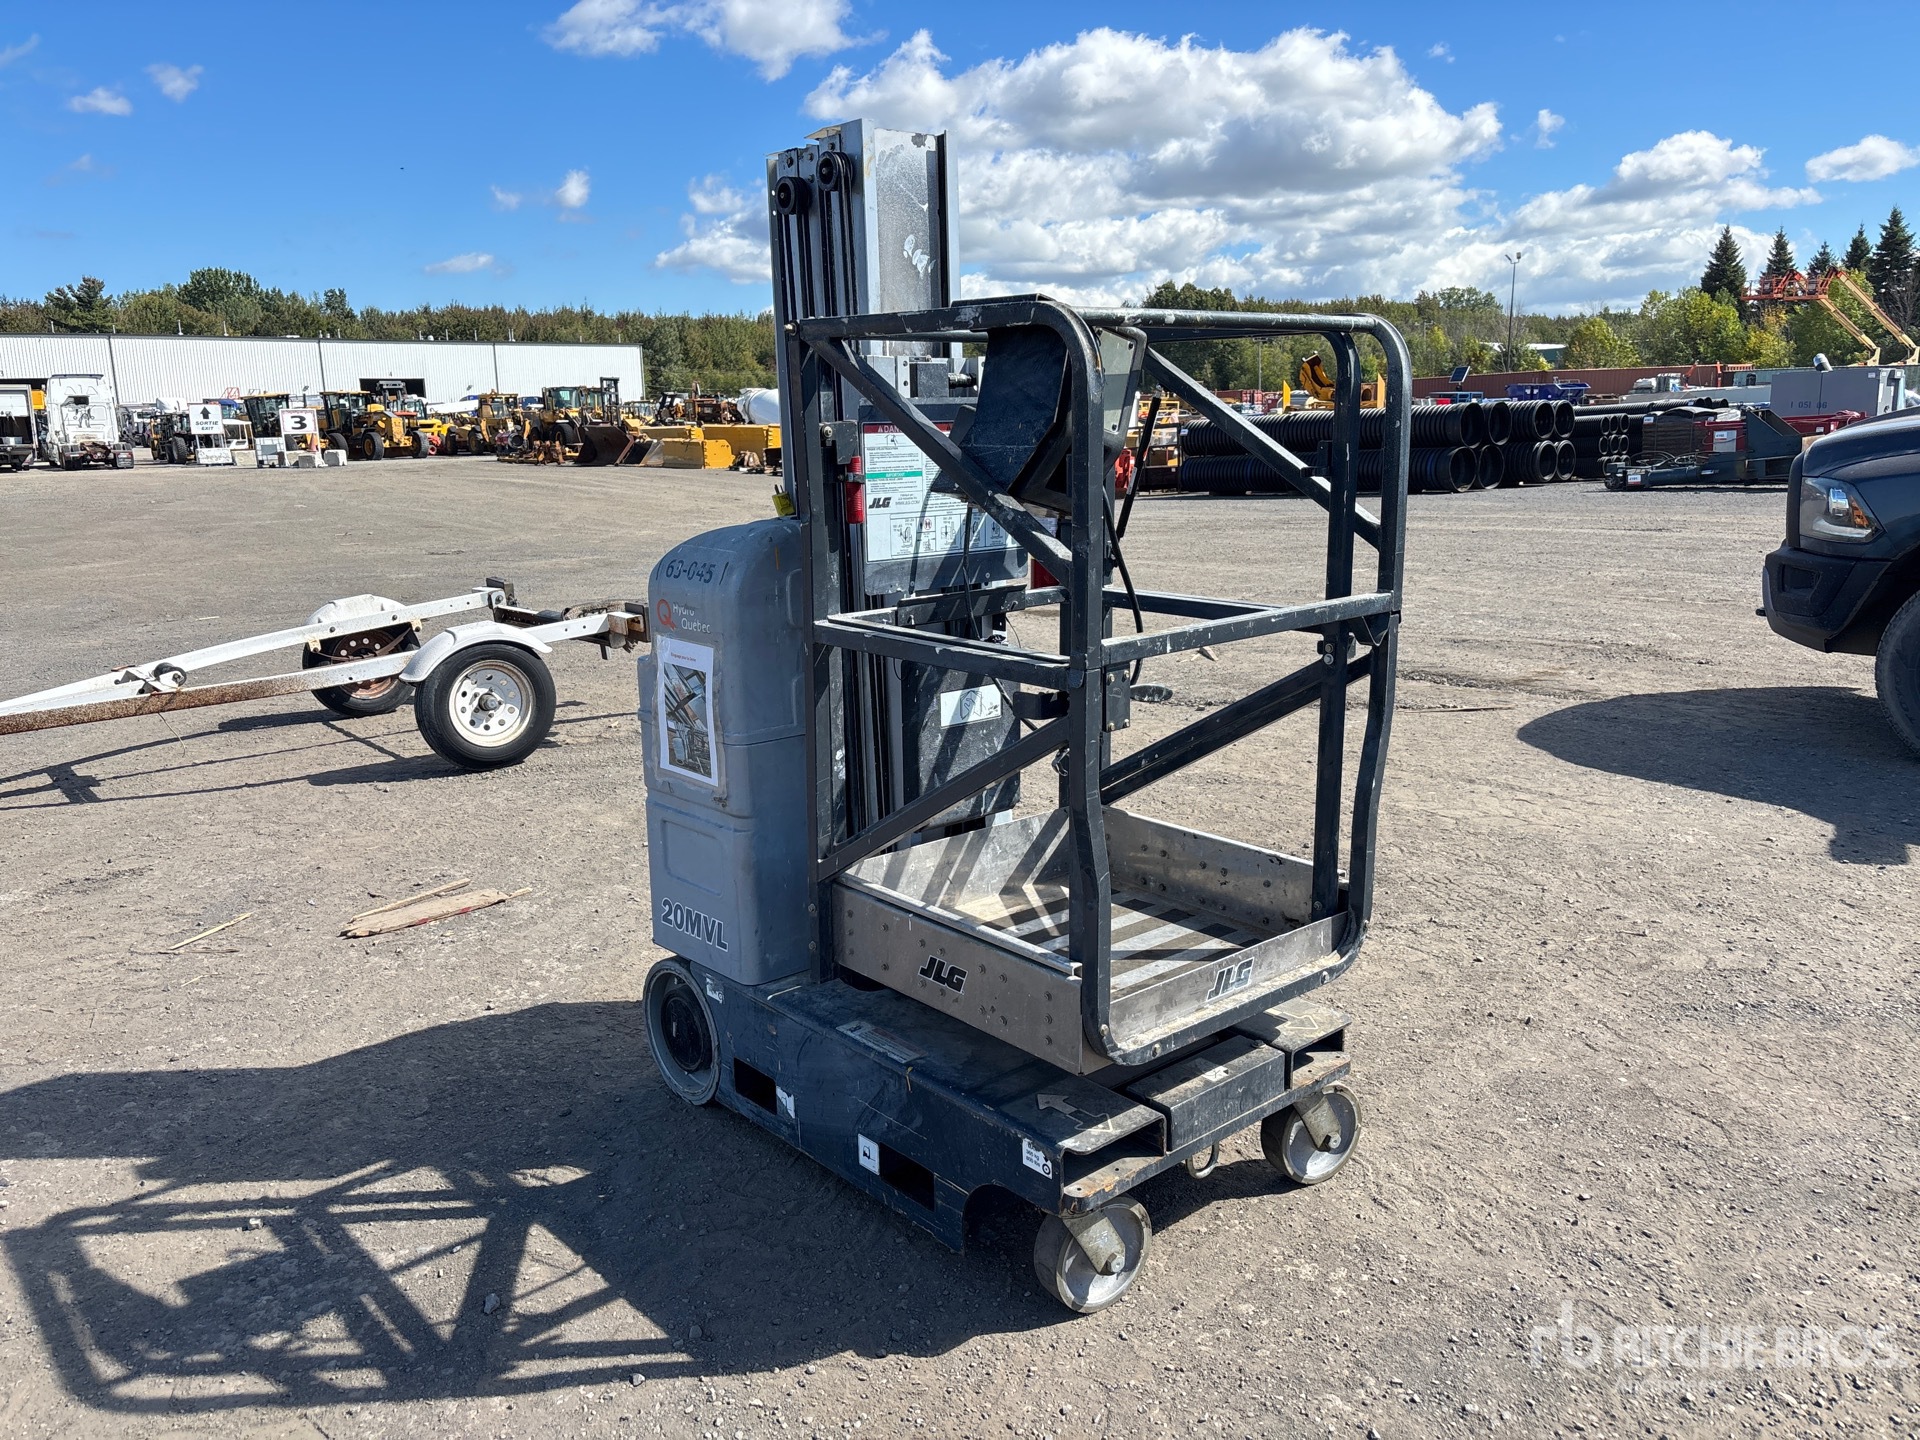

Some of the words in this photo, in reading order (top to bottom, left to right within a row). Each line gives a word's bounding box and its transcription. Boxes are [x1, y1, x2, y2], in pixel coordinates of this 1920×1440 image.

[290, 415, 308, 430] 3
[868, 497, 891, 509] JLG
[681, 617, 710, 633] Québec
[661, 897, 728, 952] 20MVL
[918, 954, 969, 995] JLG
[1206, 956, 1255, 1002] JLG
